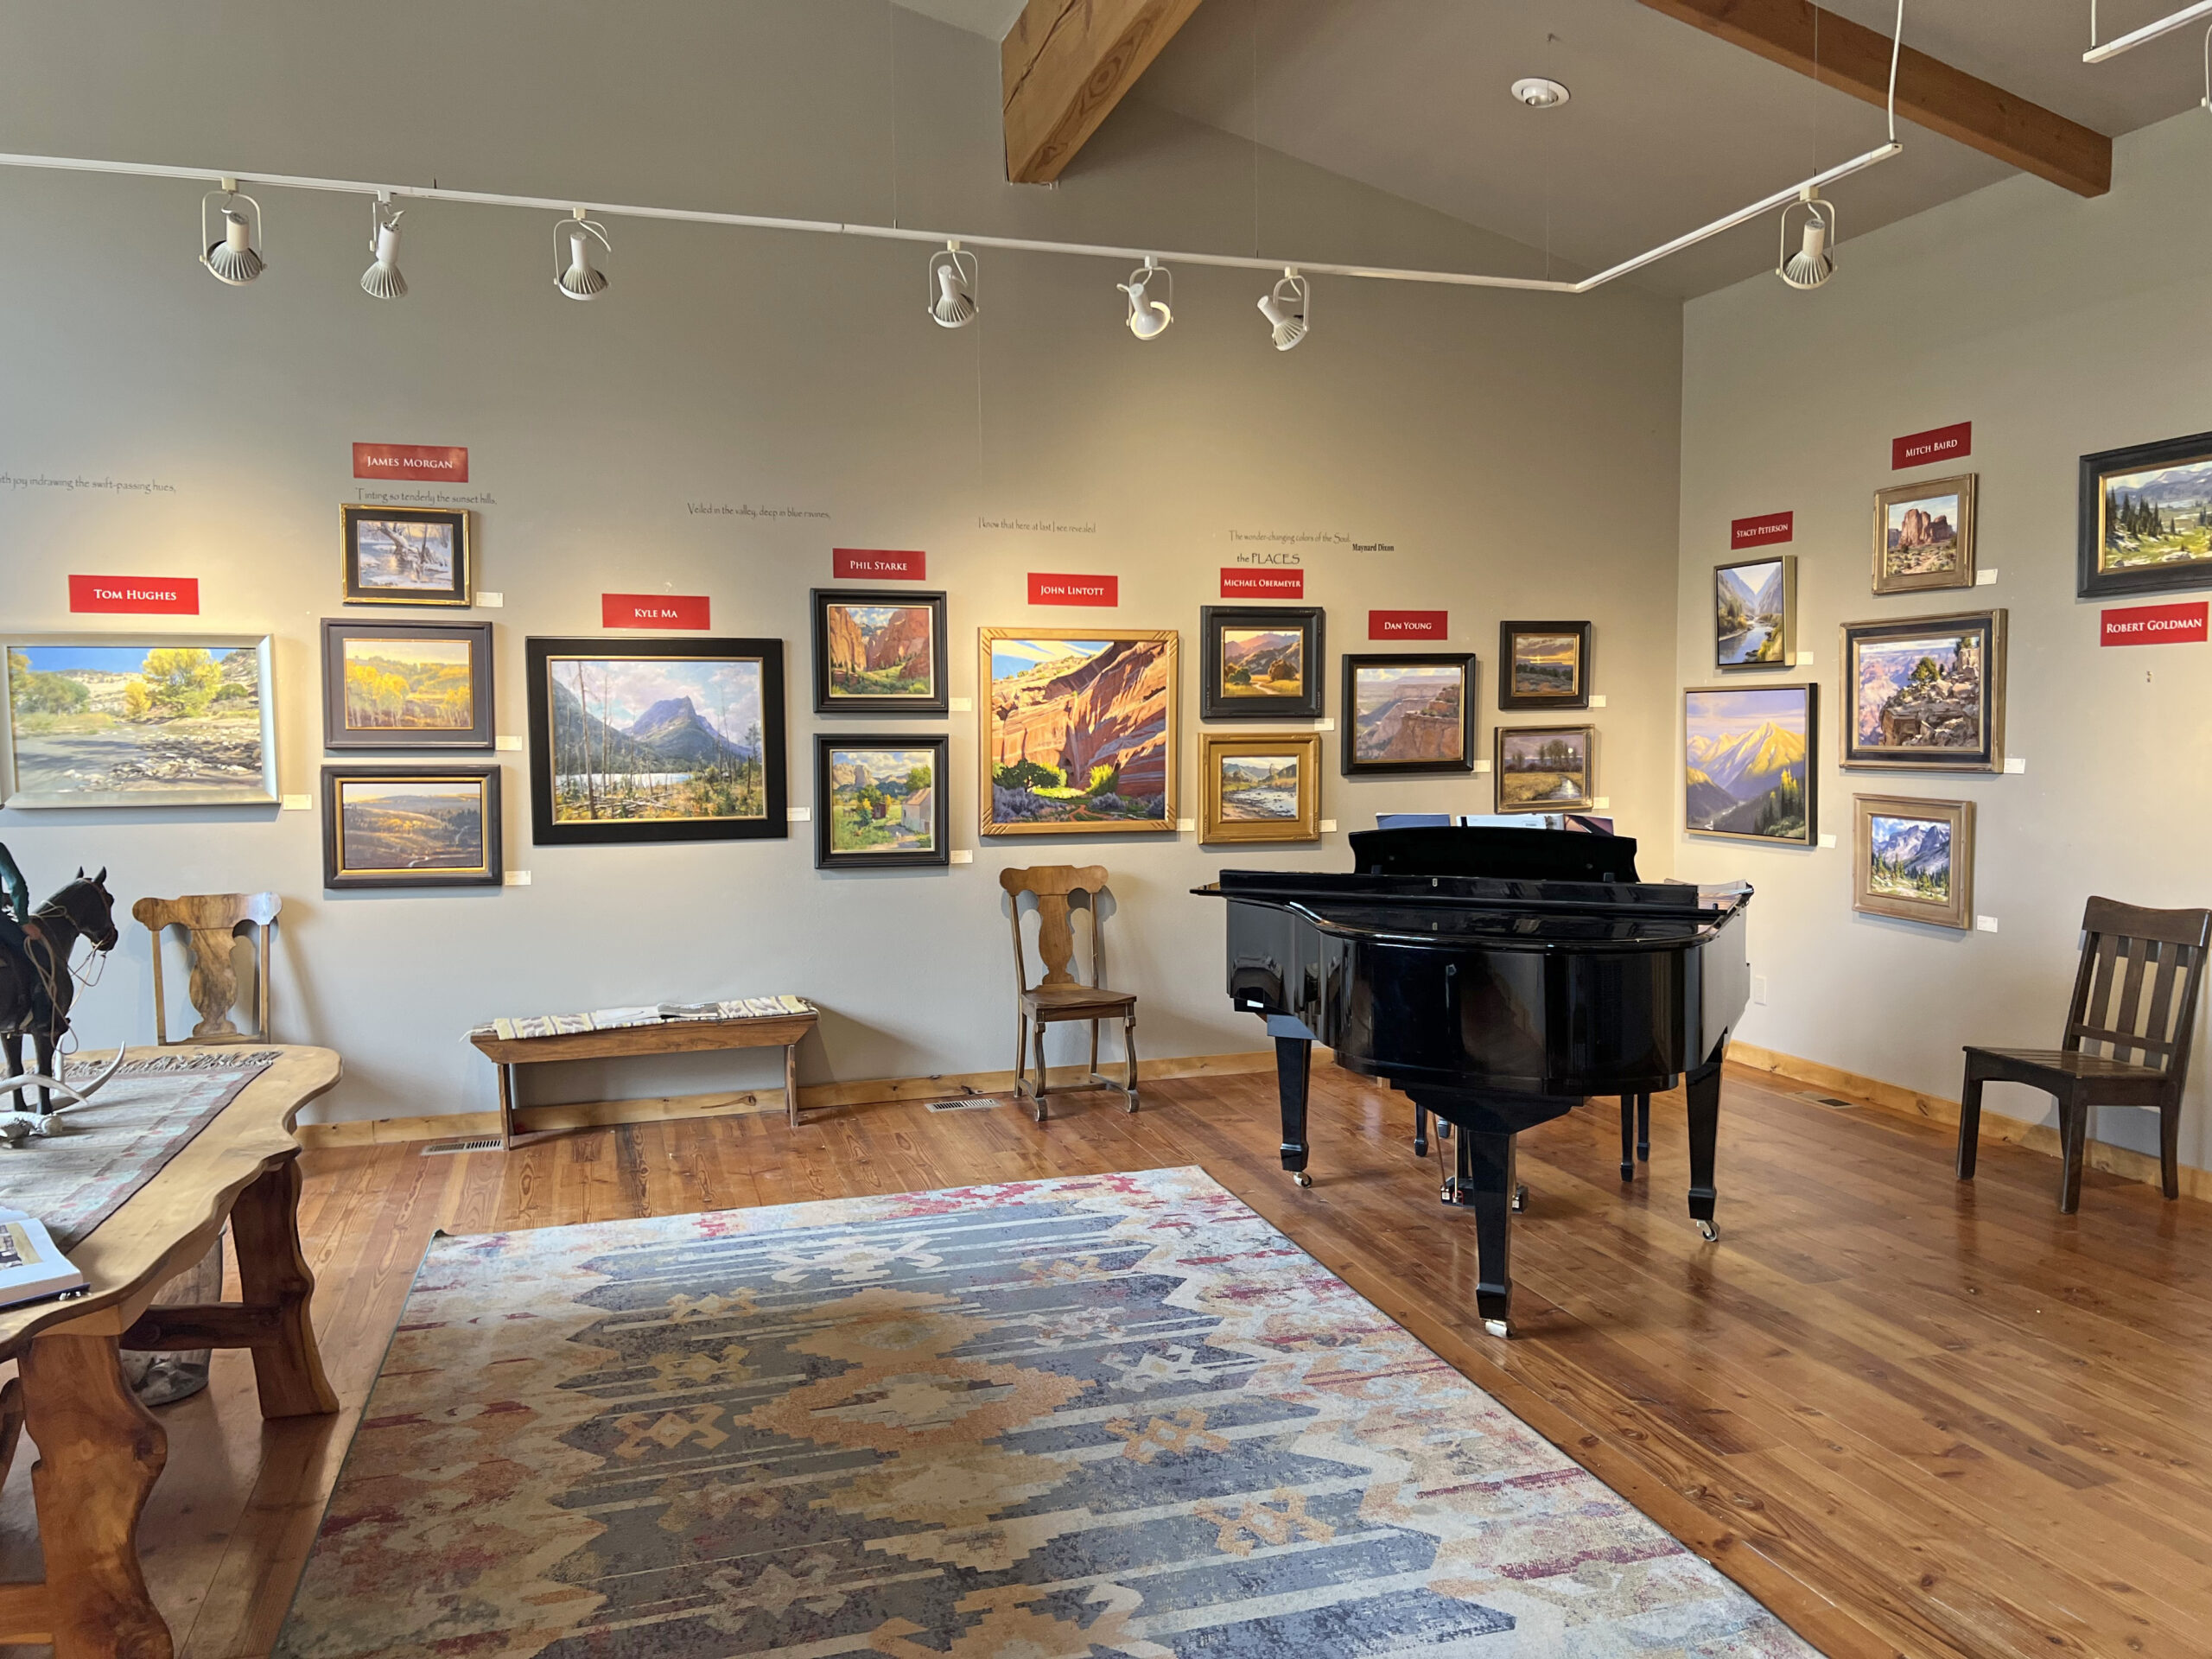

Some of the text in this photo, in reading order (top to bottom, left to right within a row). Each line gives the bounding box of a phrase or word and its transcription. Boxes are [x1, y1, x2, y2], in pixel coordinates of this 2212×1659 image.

[1905, 439, 1958, 458] MITCH BAIRD
[367, 455, 454, 468] JAMES MORGAN
[13, 477, 28, 491] joy
[75, 476, 89, 488] the
[92, 477, 152, 494] swift-passing
[355, 487, 387, 503] Tinting
[401, 491, 435, 505] tenderly
[437, 492, 450, 502] the
[452, 495, 479, 504] sunset
[687, 502, 712, 515] Veiled
[722, 504, 734, 515] the
[759, 505, 778, 520] deep
[787, 506, 803, 518] blue
[982, 518, 999, 528] know
[1001, 518, 1014, 530] that
[1015, 518, 1030, 530] here
[1039, 520, 1052, 531] last
[1069, 522, 1096, 533] revealed
[1737, 523, 1789, 538] STACEY PETERSON
[1229, 530, 1243, 542] The
[1296, 531, 1313, 543] colors
[1315, 531, 1323, 542] of
[1323, 531, 1332, 543] the
[1352, 543, 1395, 553] Maynard Dixon
[1237, 553, 1300, 564] the PLACES
[850, 560, 908, 571] PHIL STARKE
[1224, 579, 1301, 588] MICHAEL OBERMEYER
[93, 589, 177, 601] TOM HUGHES
[1040, 585, 1104, 596] JOHN LINTOTT
[634, 608, 678, 619] KYLE MA
[1384, 621, 1432, 630] DAN YOUNG
[2107, 618, 2202, 634] ROBERT GOLDMAN
